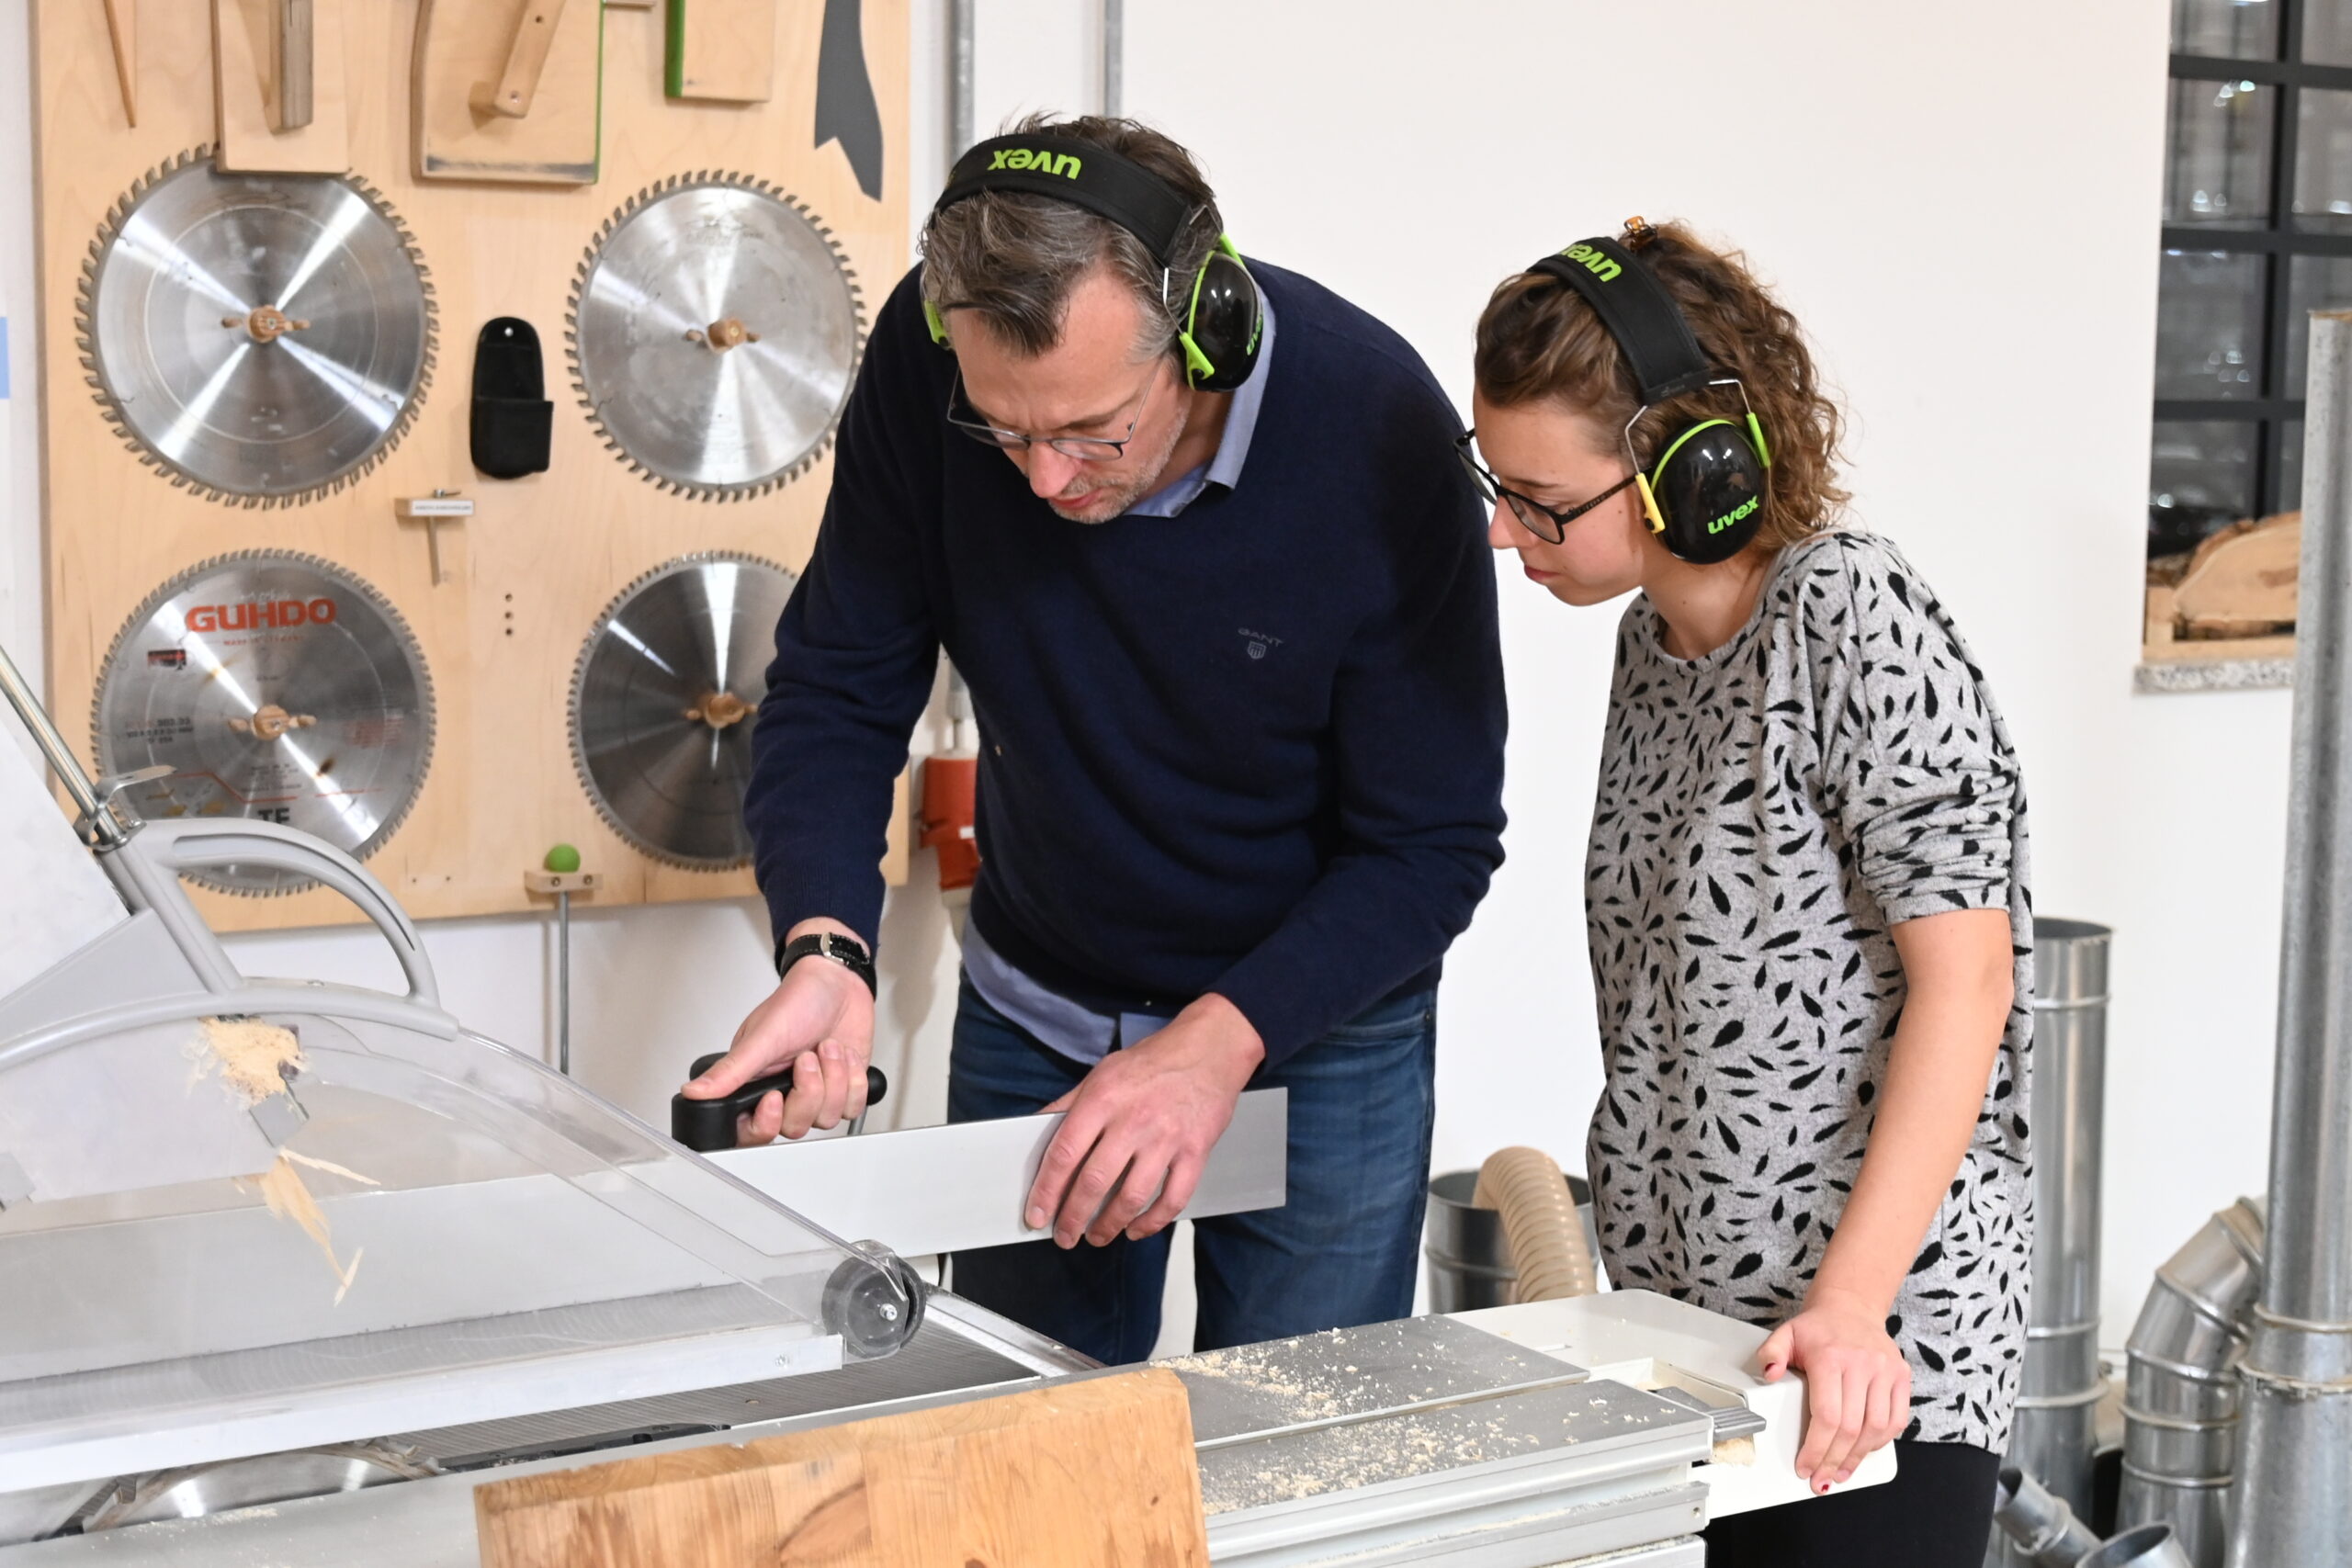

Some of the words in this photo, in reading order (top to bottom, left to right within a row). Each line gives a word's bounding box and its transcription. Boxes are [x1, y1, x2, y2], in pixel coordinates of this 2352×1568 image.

[987, 148, 1082, 180] uvex
[1707, 494, 1758, 535] uvex
[185, 598, 336, 633] GUHDO
